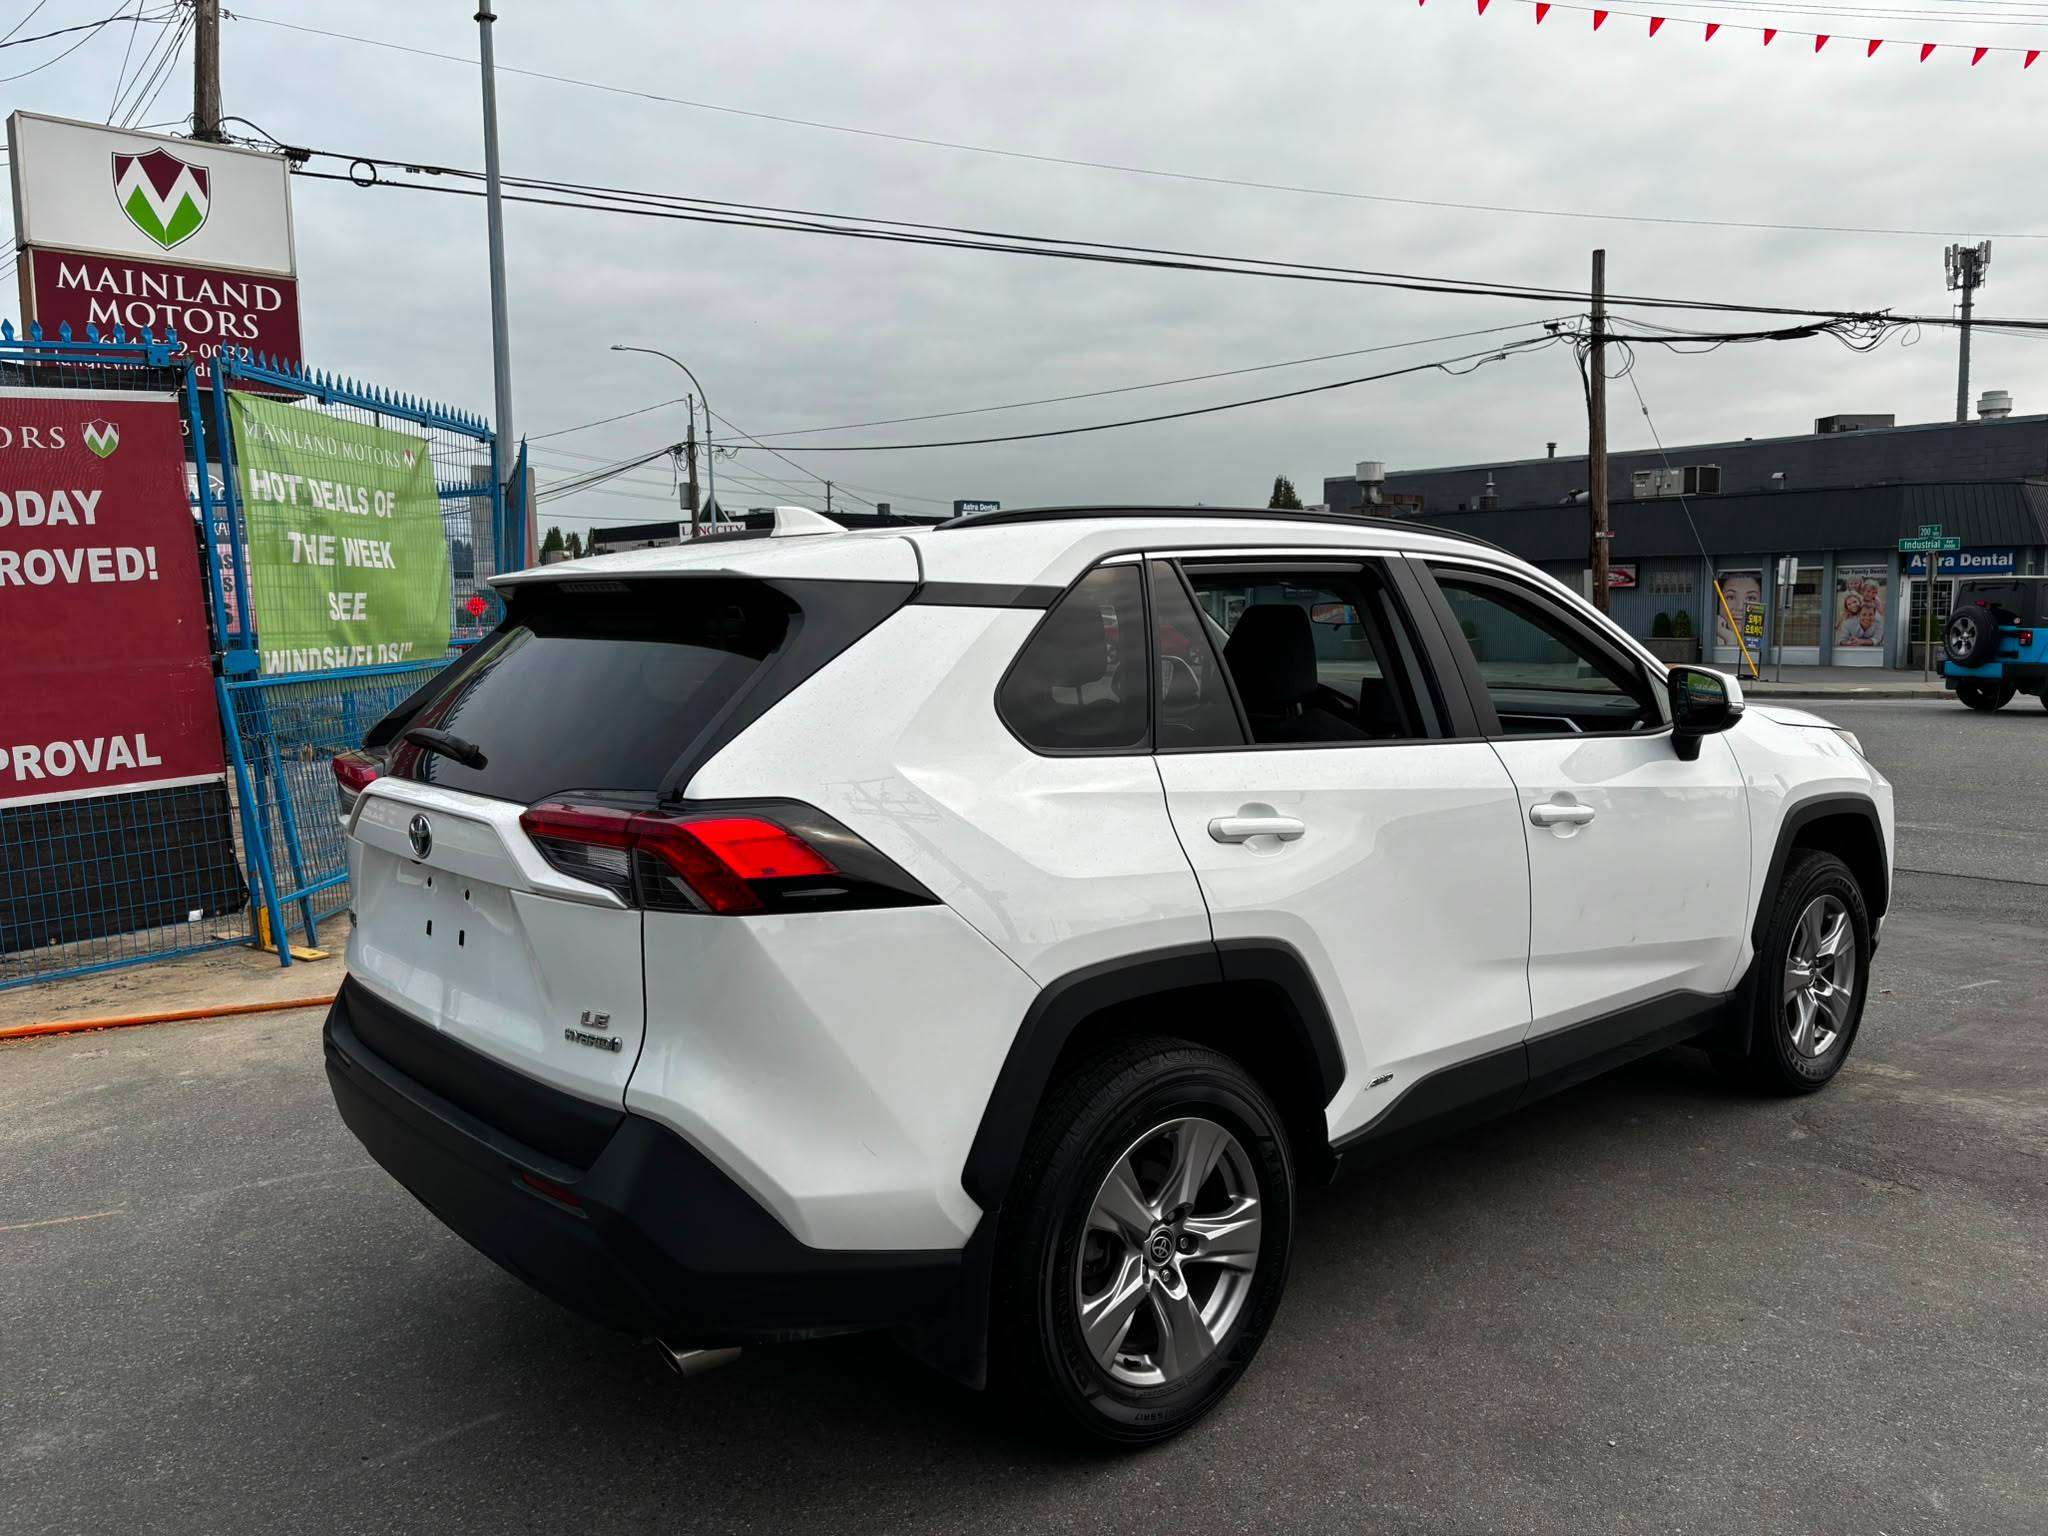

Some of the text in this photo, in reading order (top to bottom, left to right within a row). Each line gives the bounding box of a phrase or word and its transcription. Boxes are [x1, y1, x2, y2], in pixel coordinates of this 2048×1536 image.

[56, 263, 282, 312] MAINLAND
[86, 297, 260, 340] MOTORS
[243, 419, 337, 456] MAINLAND
[342, 440, 400, 468] MOTORS
[248, 467, 395, 518] HOT DEALS OF
[1904, 539, 1941, 550] Industrial
[1920, 527, 1931, 536] 200
[287, 531, 396, 570] THE WEEK
[1960, 552, 2013, 567] Dental
[327, 591, 367, 622] SEE
[581, 1009, 610, 1028] LE
